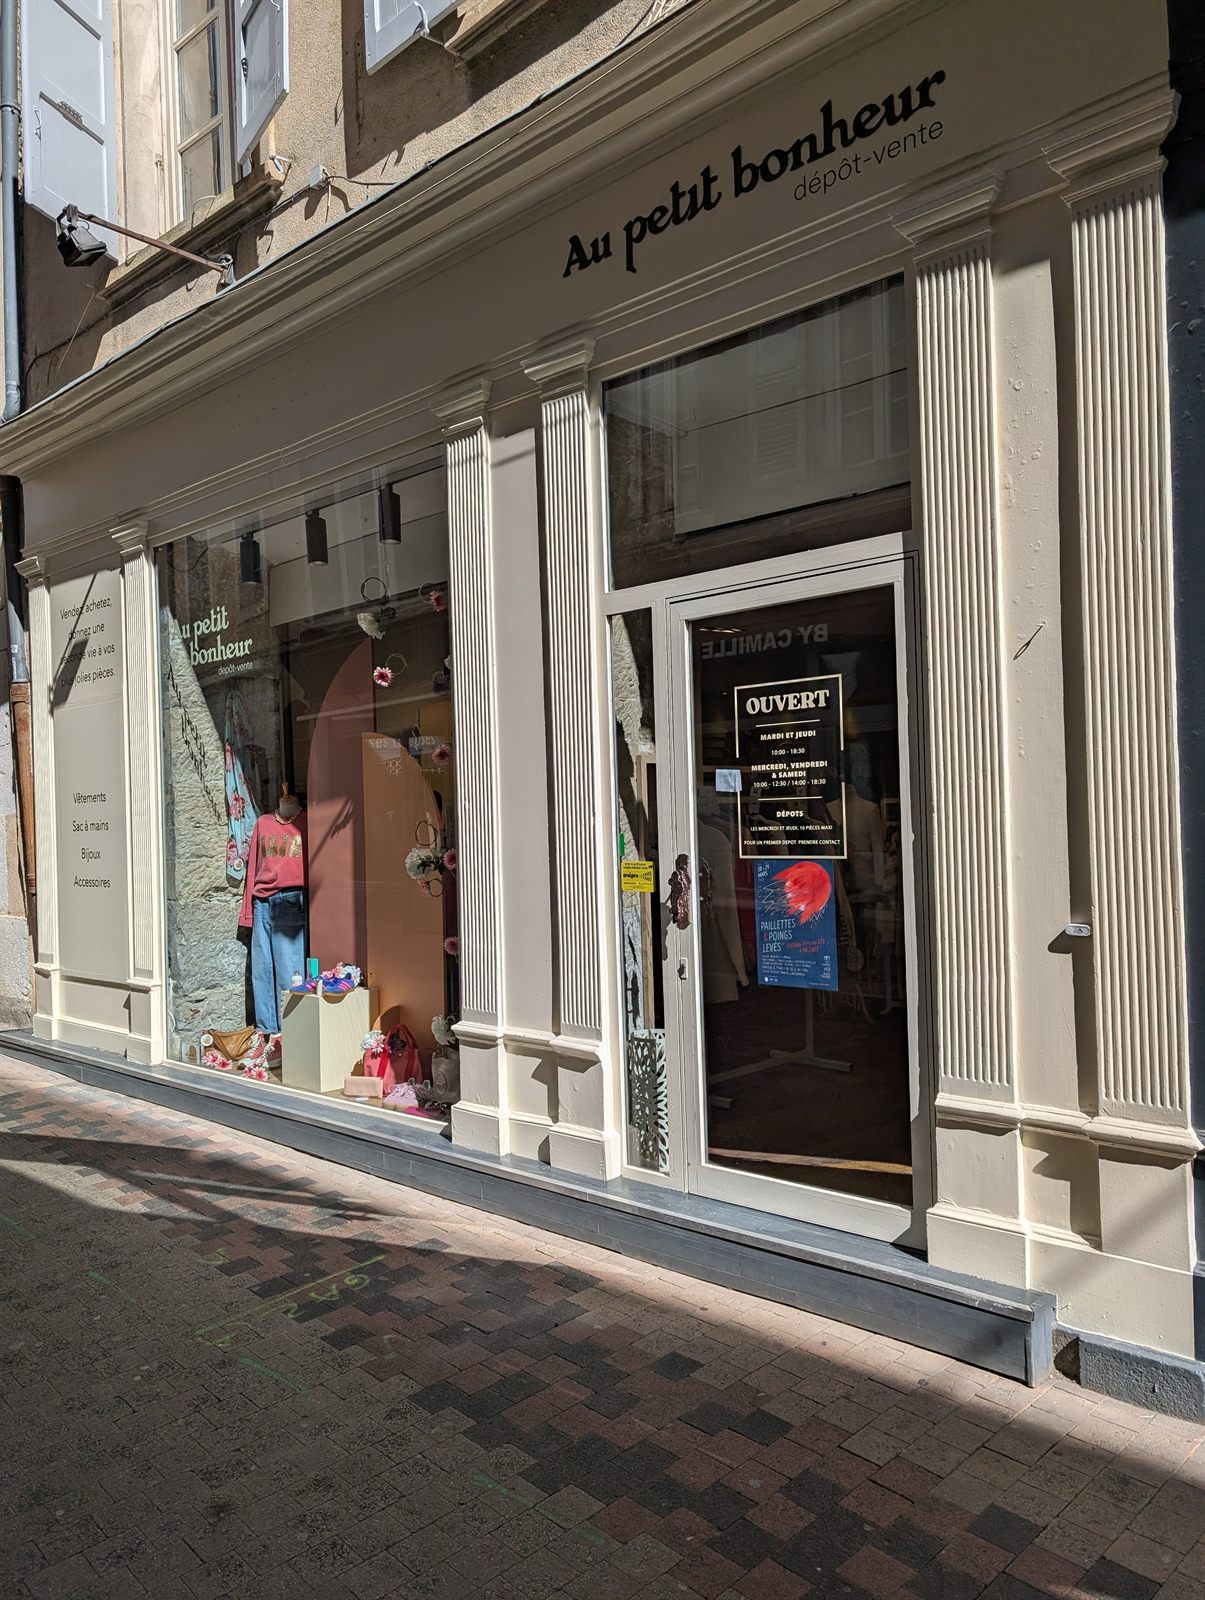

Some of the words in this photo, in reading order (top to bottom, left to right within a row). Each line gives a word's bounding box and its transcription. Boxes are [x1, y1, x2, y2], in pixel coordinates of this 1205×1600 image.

[793, 120, 944, 201] dépôt-vente
[562, 233, 613, 278] Au
[623, 165, 722, 274] petit
[731, 69, 946, 199] bonheur
[92, 623, 105, 634] une
[193, 605, 230, 652] petit
[87, 646, 97, 658] vie
[97, 644, 102, 656] à
[103, 643, 115, 655] vos
[188, 634, 253, 667] bonheur
[745, 689, 830, 715] OUVERT
[760, 732, 784, 741] MARDI
[785, 731, 795, 739] ET
[795, 730, 816, 740] JEUDI
[790, 747, 806, 755] 18:30
[751, 763, 789, 772] MERCREDI,
[790, 760, 828, 769] VENDREDI
[778, 770, 806, 779] SAMEDI
[73, 792, 106, 804] Vêtements
[72, 820, 83, 832] Sac
[85, 820, 88, 832] à
[90, 819, 109, 831] mains
[81, 848, 101, 862] Bijoux
[73, 876, 111, 888] Accessoires
[760, 918, 796, 931] PAILLETTES
[768, 930, 793, 942] POINGS
